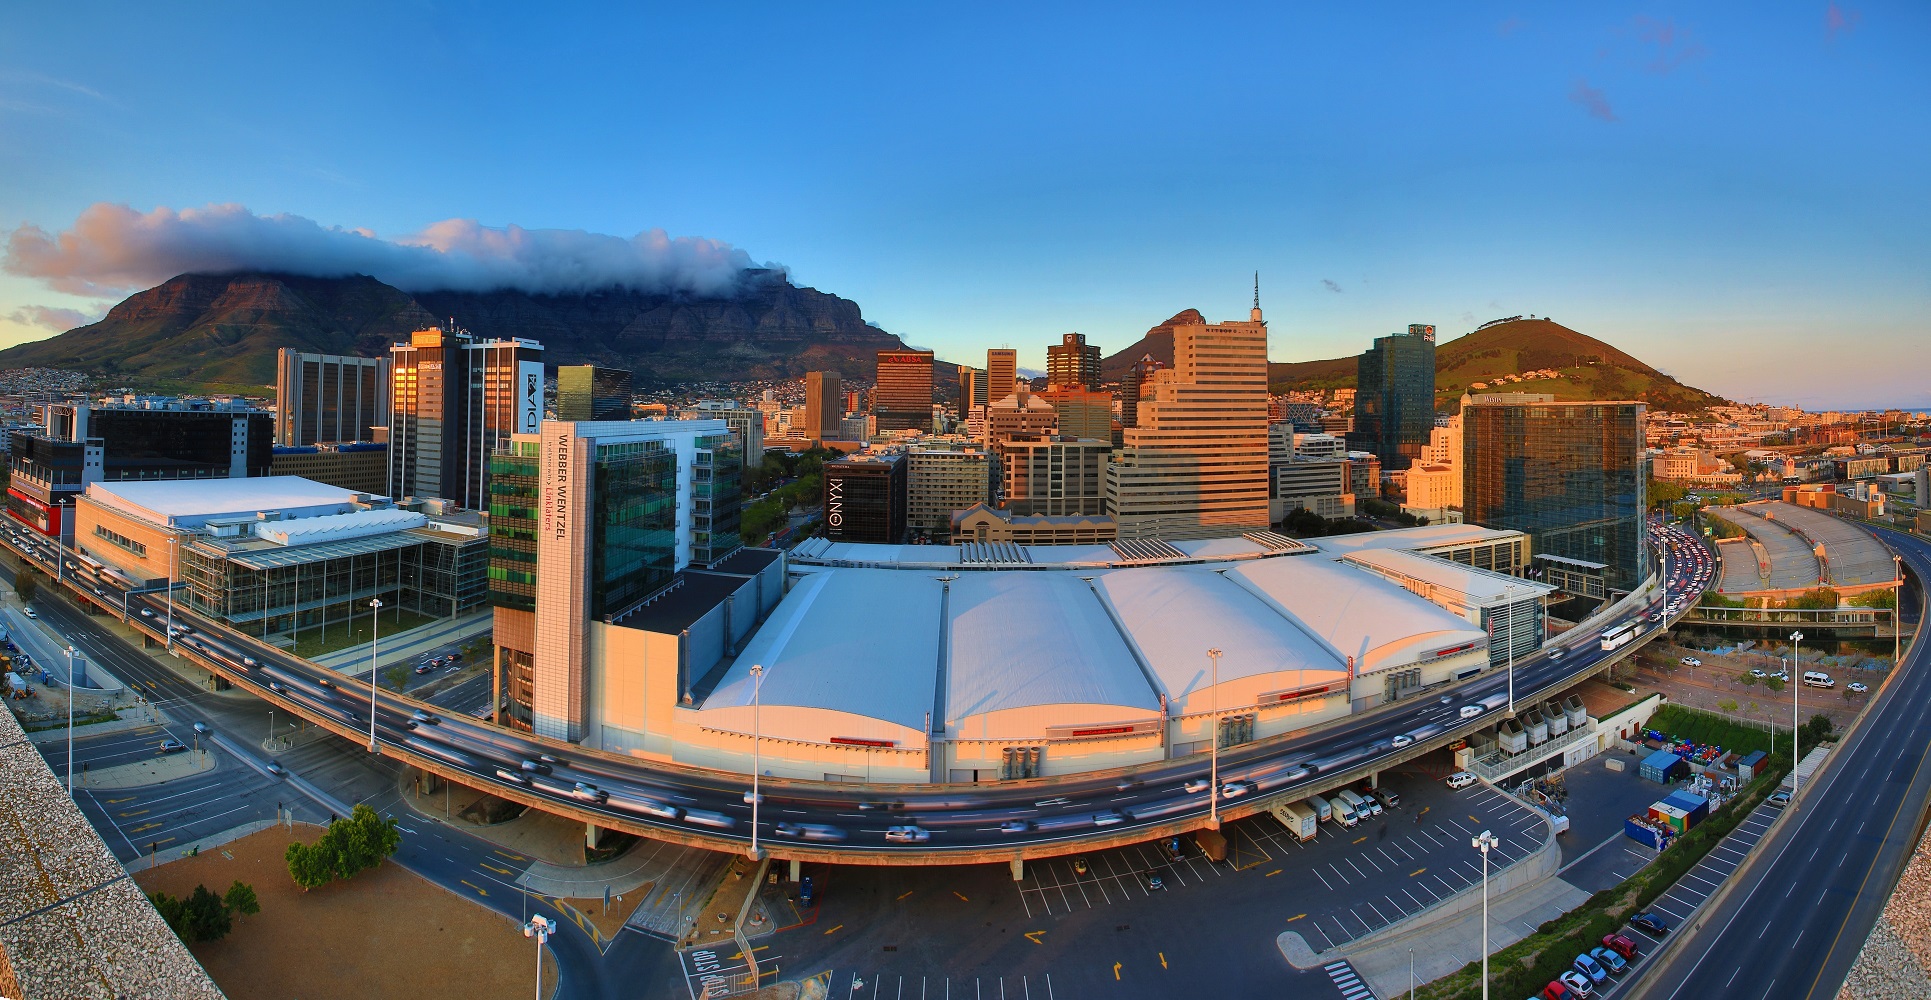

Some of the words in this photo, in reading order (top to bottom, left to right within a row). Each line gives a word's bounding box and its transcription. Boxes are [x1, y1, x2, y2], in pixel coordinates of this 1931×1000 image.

[557, 434, 568, 482] WEBBER
[545, 487, 553, 531] Linklaters
[556, 485, 567, 541] WENTZEL
[829, 482, 843, 527] ONYX
[692, 950, 720, 972] STOP
